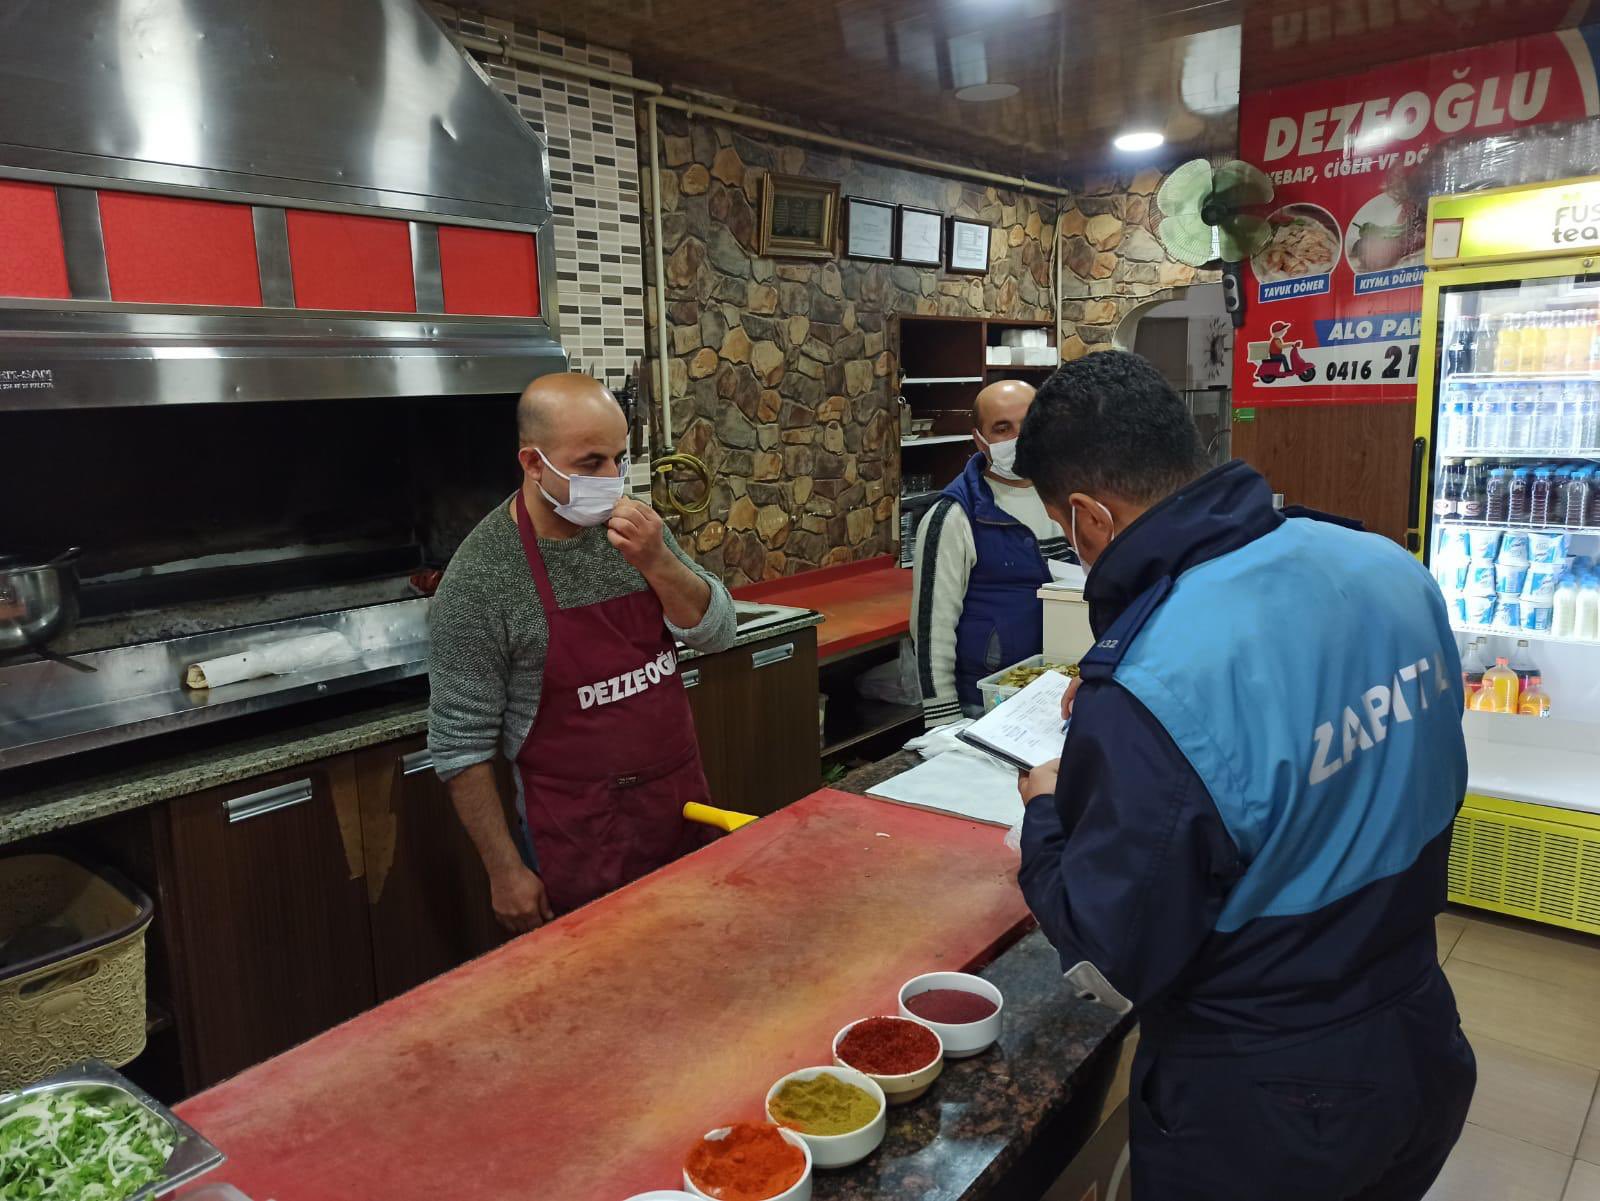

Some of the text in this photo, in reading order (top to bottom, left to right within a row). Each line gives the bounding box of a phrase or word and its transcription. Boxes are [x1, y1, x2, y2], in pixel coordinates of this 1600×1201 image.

[1552, 226, 1598, 244] tea
[1264, 279, 1325, 298] TAVUK DÖNER
[1360, 275, 1390, 290] KIYMA
[1327, 320, 1373, 341] ALO
[1326, 360, 1372, 382] 0416
